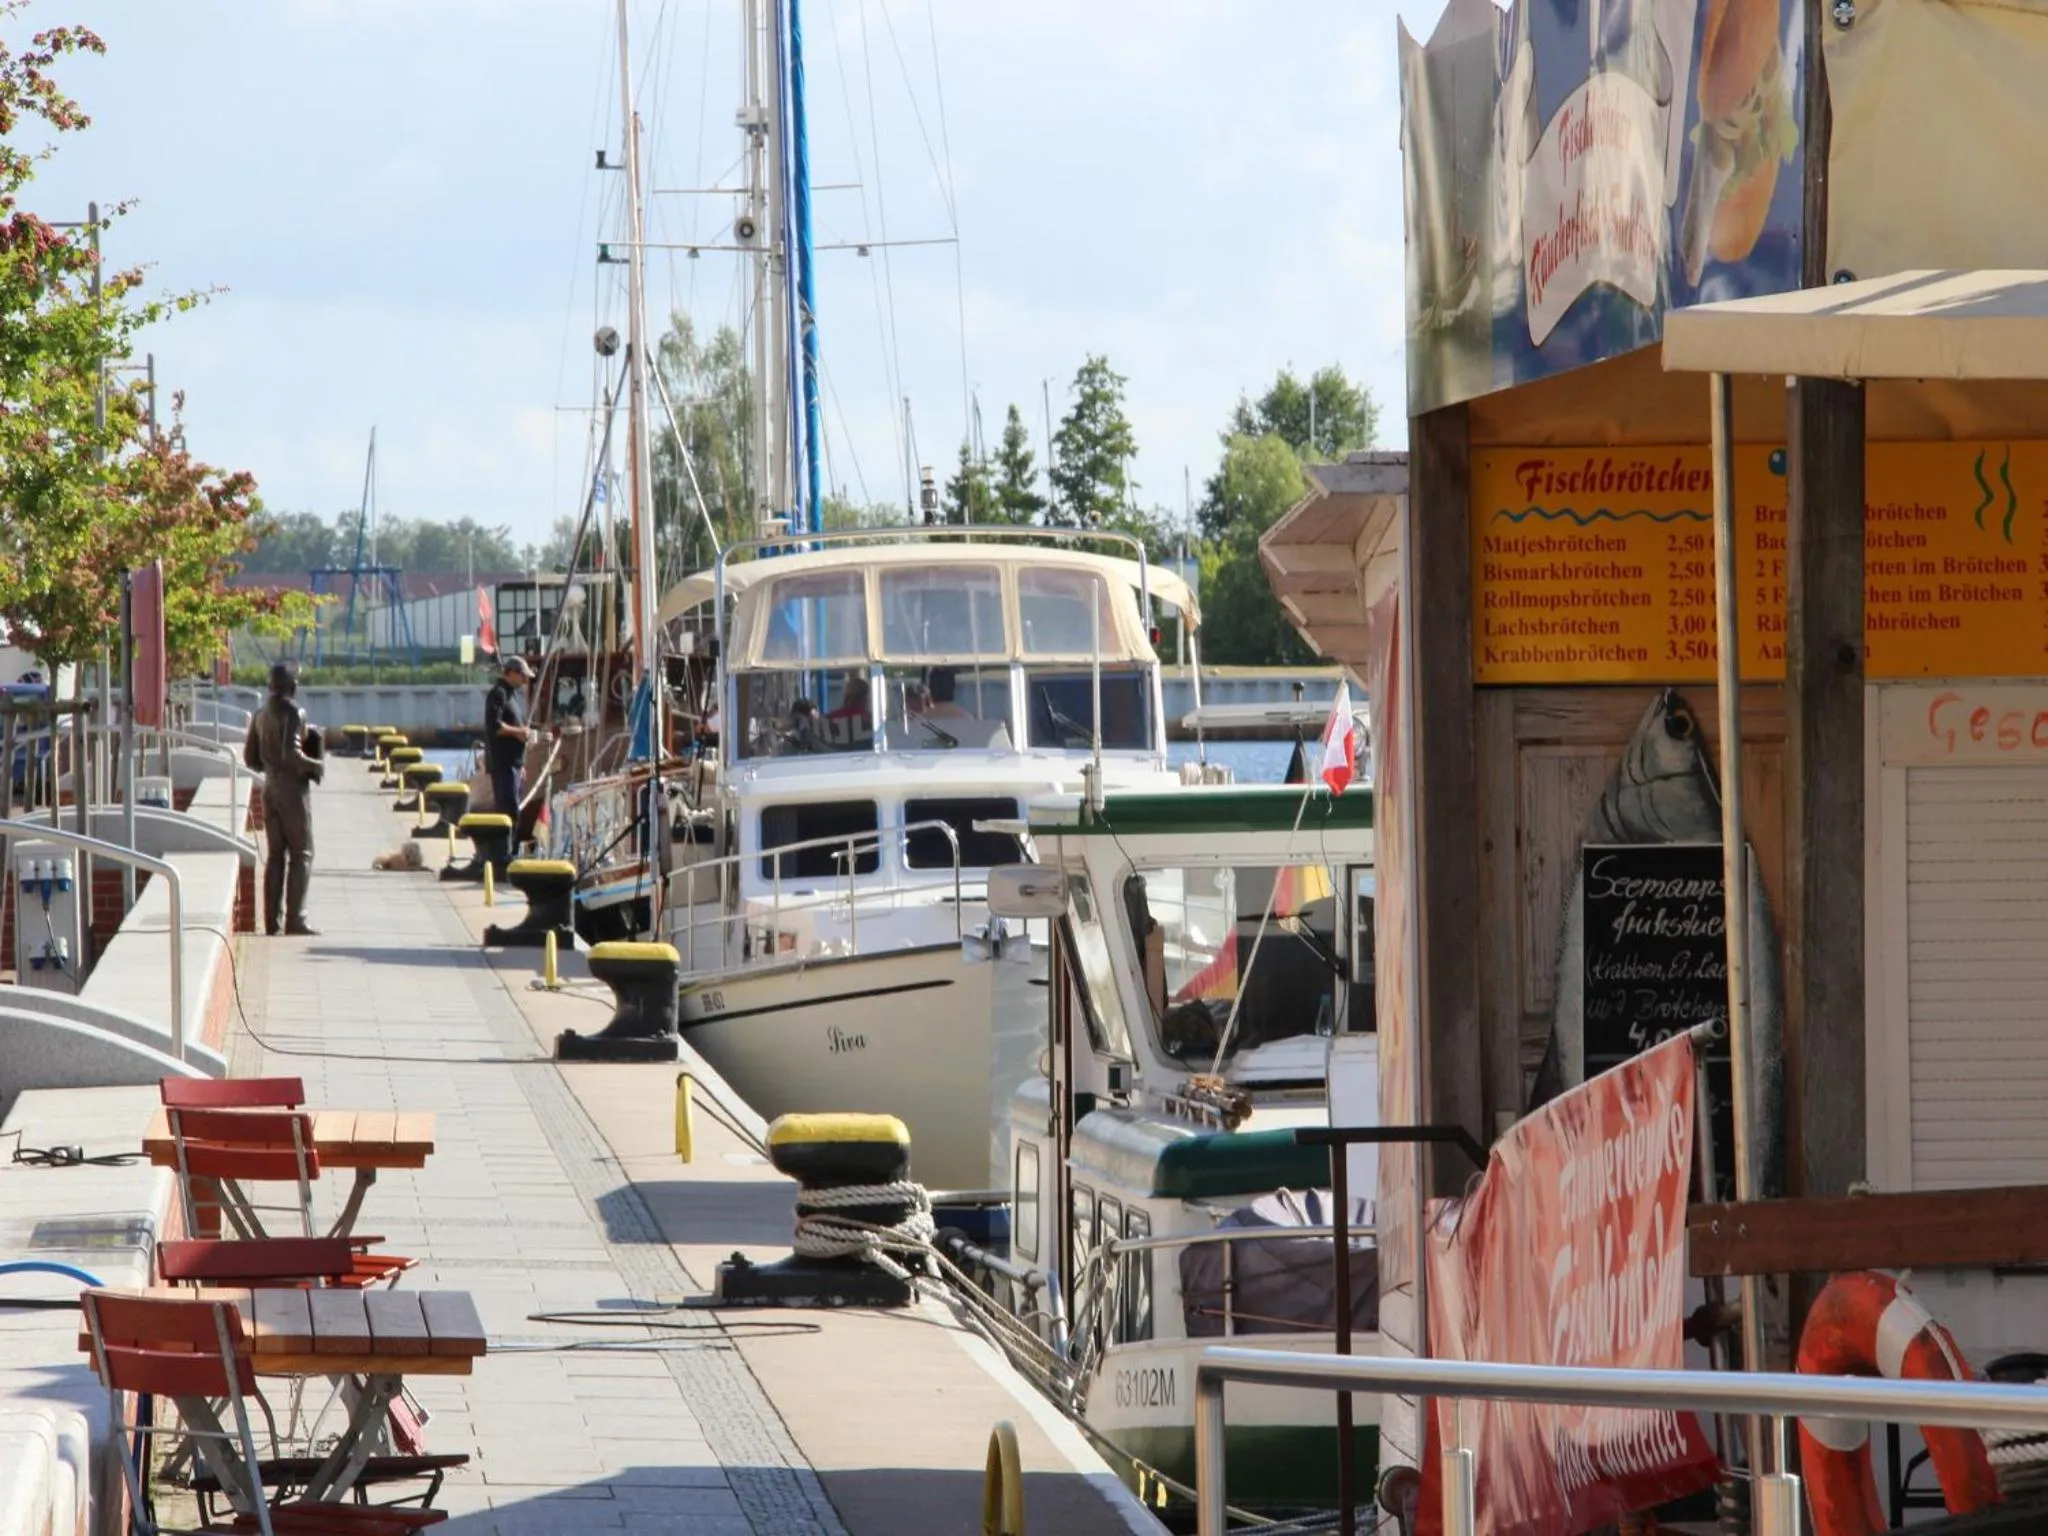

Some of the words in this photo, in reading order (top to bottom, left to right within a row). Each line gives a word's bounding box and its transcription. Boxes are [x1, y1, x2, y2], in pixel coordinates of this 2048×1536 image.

[1483, 535, 1627, 557] Matjesbrötchen
[1667, 534, 1704, 552] 2,50
[1483, 562, 1643, 582] Bismarkbrötchen
[1668, 561, 1705, 580] 2,50
[1913, 557, 1936, 575] im
[1943, 555, 2028, 575] Brötchen
[1483, 589, 1652, 611] Rollmopsbrötchen
[1668, 588, 1705, 607] 2,50
[1909, 585, 1932, 603] im
[1938, 583, 2023, 602] Brötchen
[1484, 616, 1620, 637] Lachsbrötchen
[1667, 615, 1706, 636] 3,00
[1483, 642, 1648, 664] Krabbenbrötchen
[1666, 640, 1708, 662] 3,50
